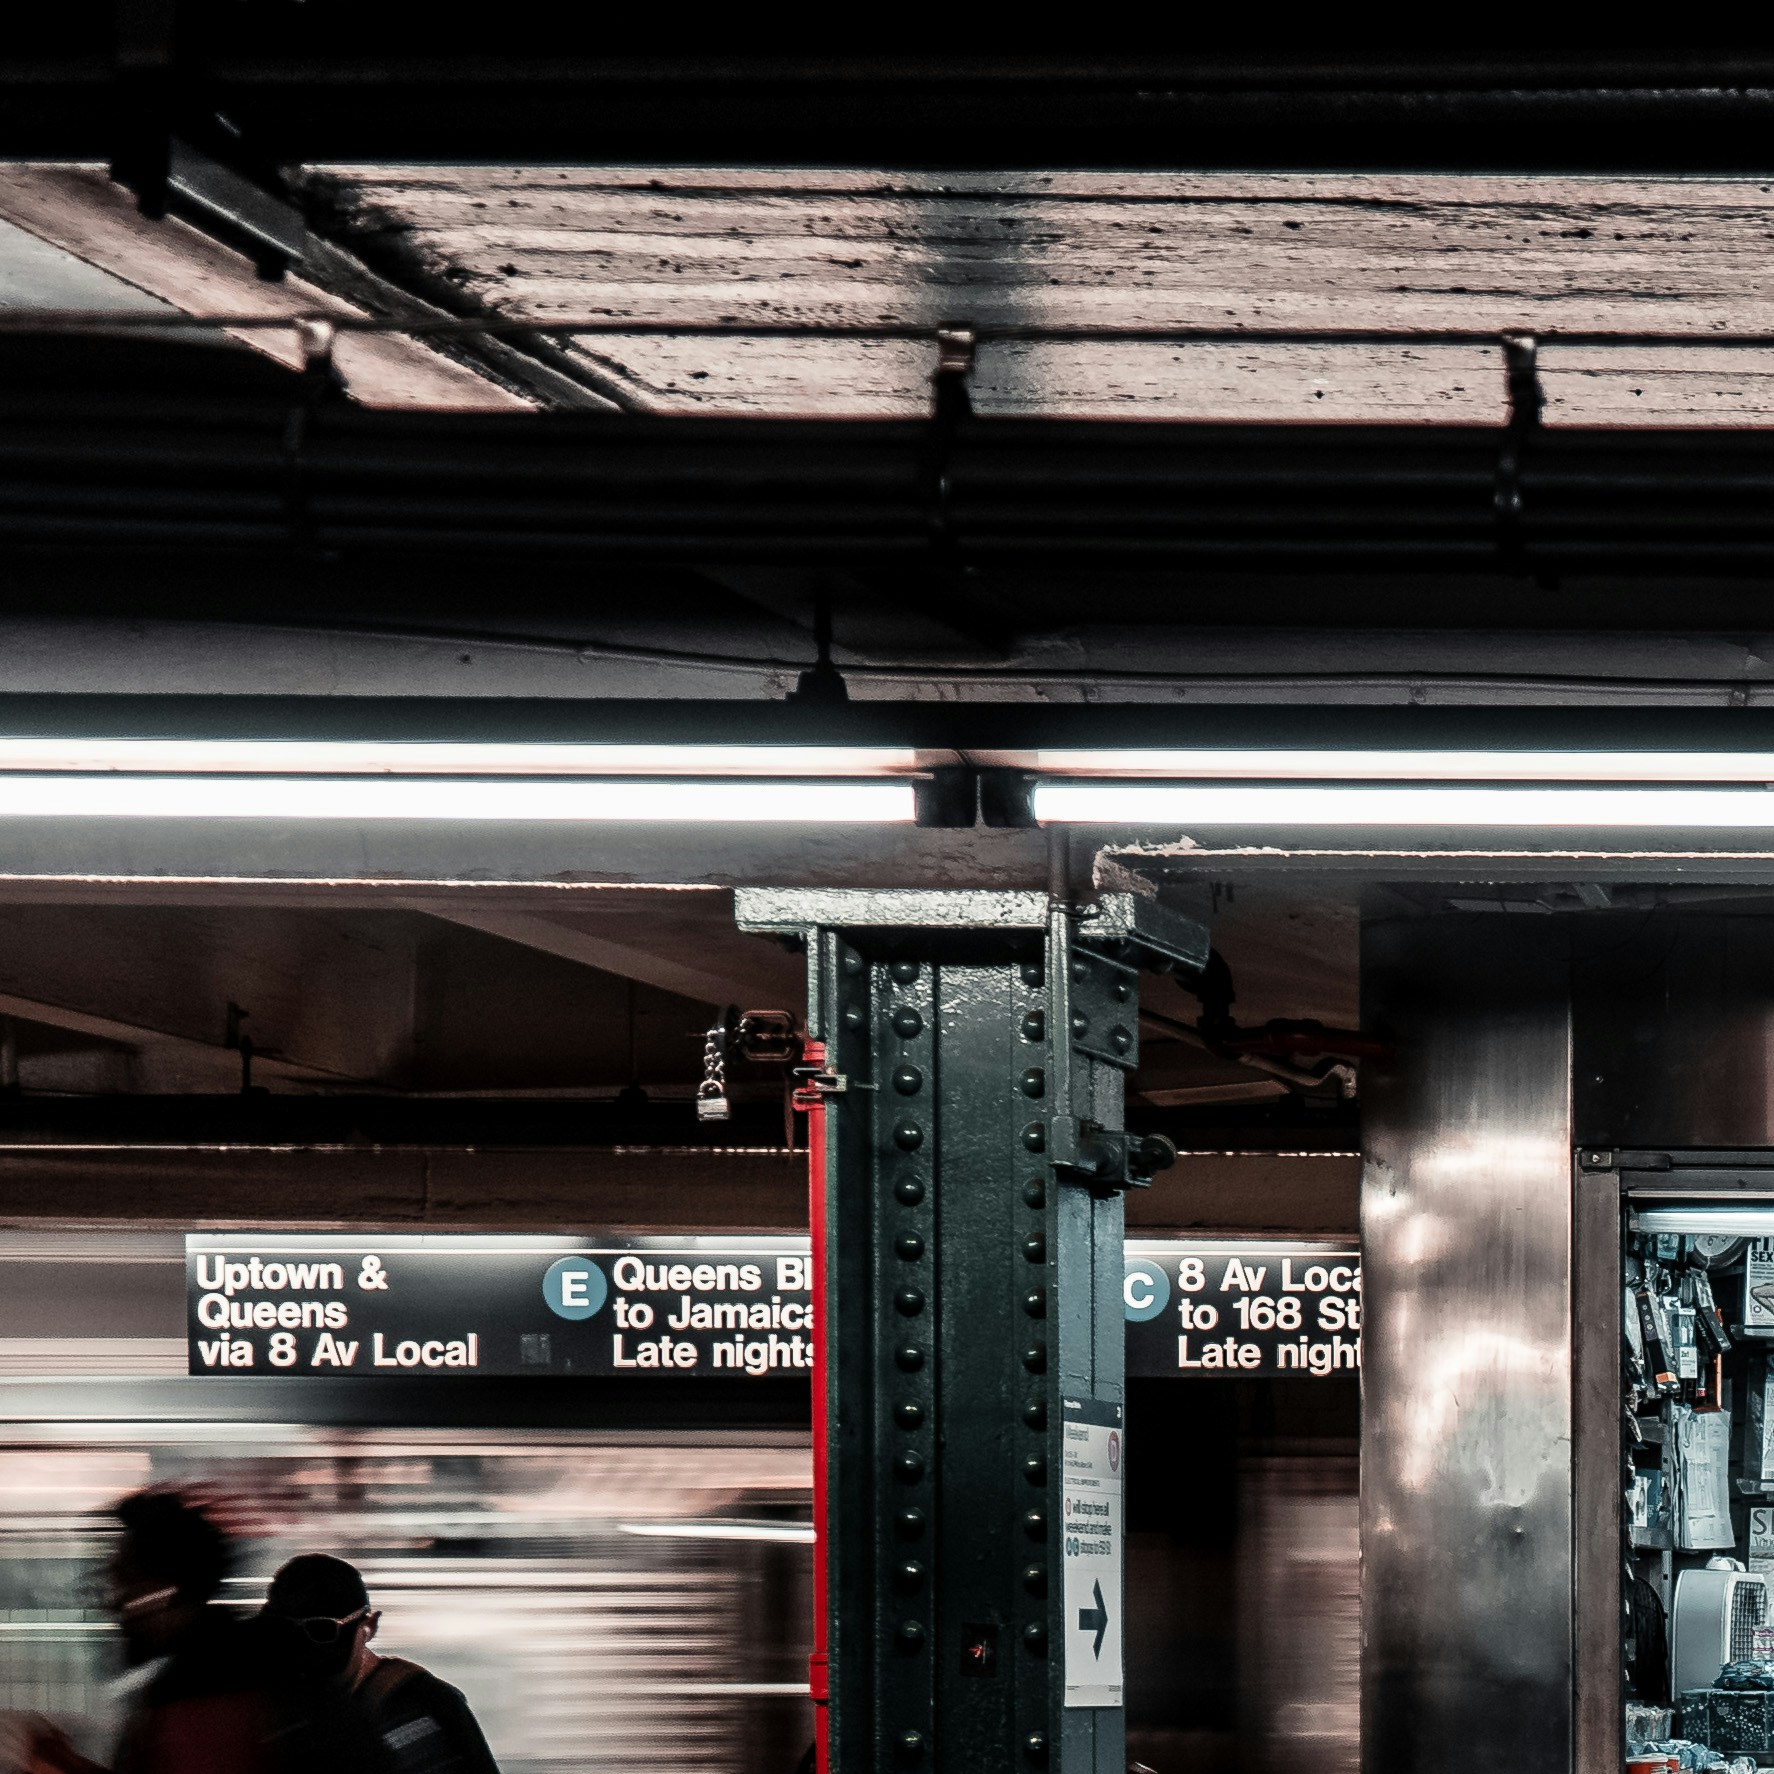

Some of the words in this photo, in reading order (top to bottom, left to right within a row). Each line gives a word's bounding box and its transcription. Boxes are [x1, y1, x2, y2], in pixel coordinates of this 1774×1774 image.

[196, 1255, 345, 1297] Uptown
[357, 1255, 390, 1291] &
[561, 1271, 589, 1307] E
[613, 1256, 761, 1292] Queens
[1123, 1271, 1154, 1309] C
[1178, 1257, 1206, 1292] 8
[1220, 1258, 1267, 1291] Av
[197, 1292, 349, 1329] Queens
[613, 1297, 654, 1330] to
[1178, 1297, 1219, 1330] to
[1232, 1296, 1302, 1331] 168
[197, 1332, 255, 1367] via
[268, 1332, 298, 1367] 8
[310, 1332, 360, 1367] Av
[374, 1332, 478, 1367] Local
[613, 1333, 699, 1368] Late
[1178, 1335, 1262, 1368] Late
